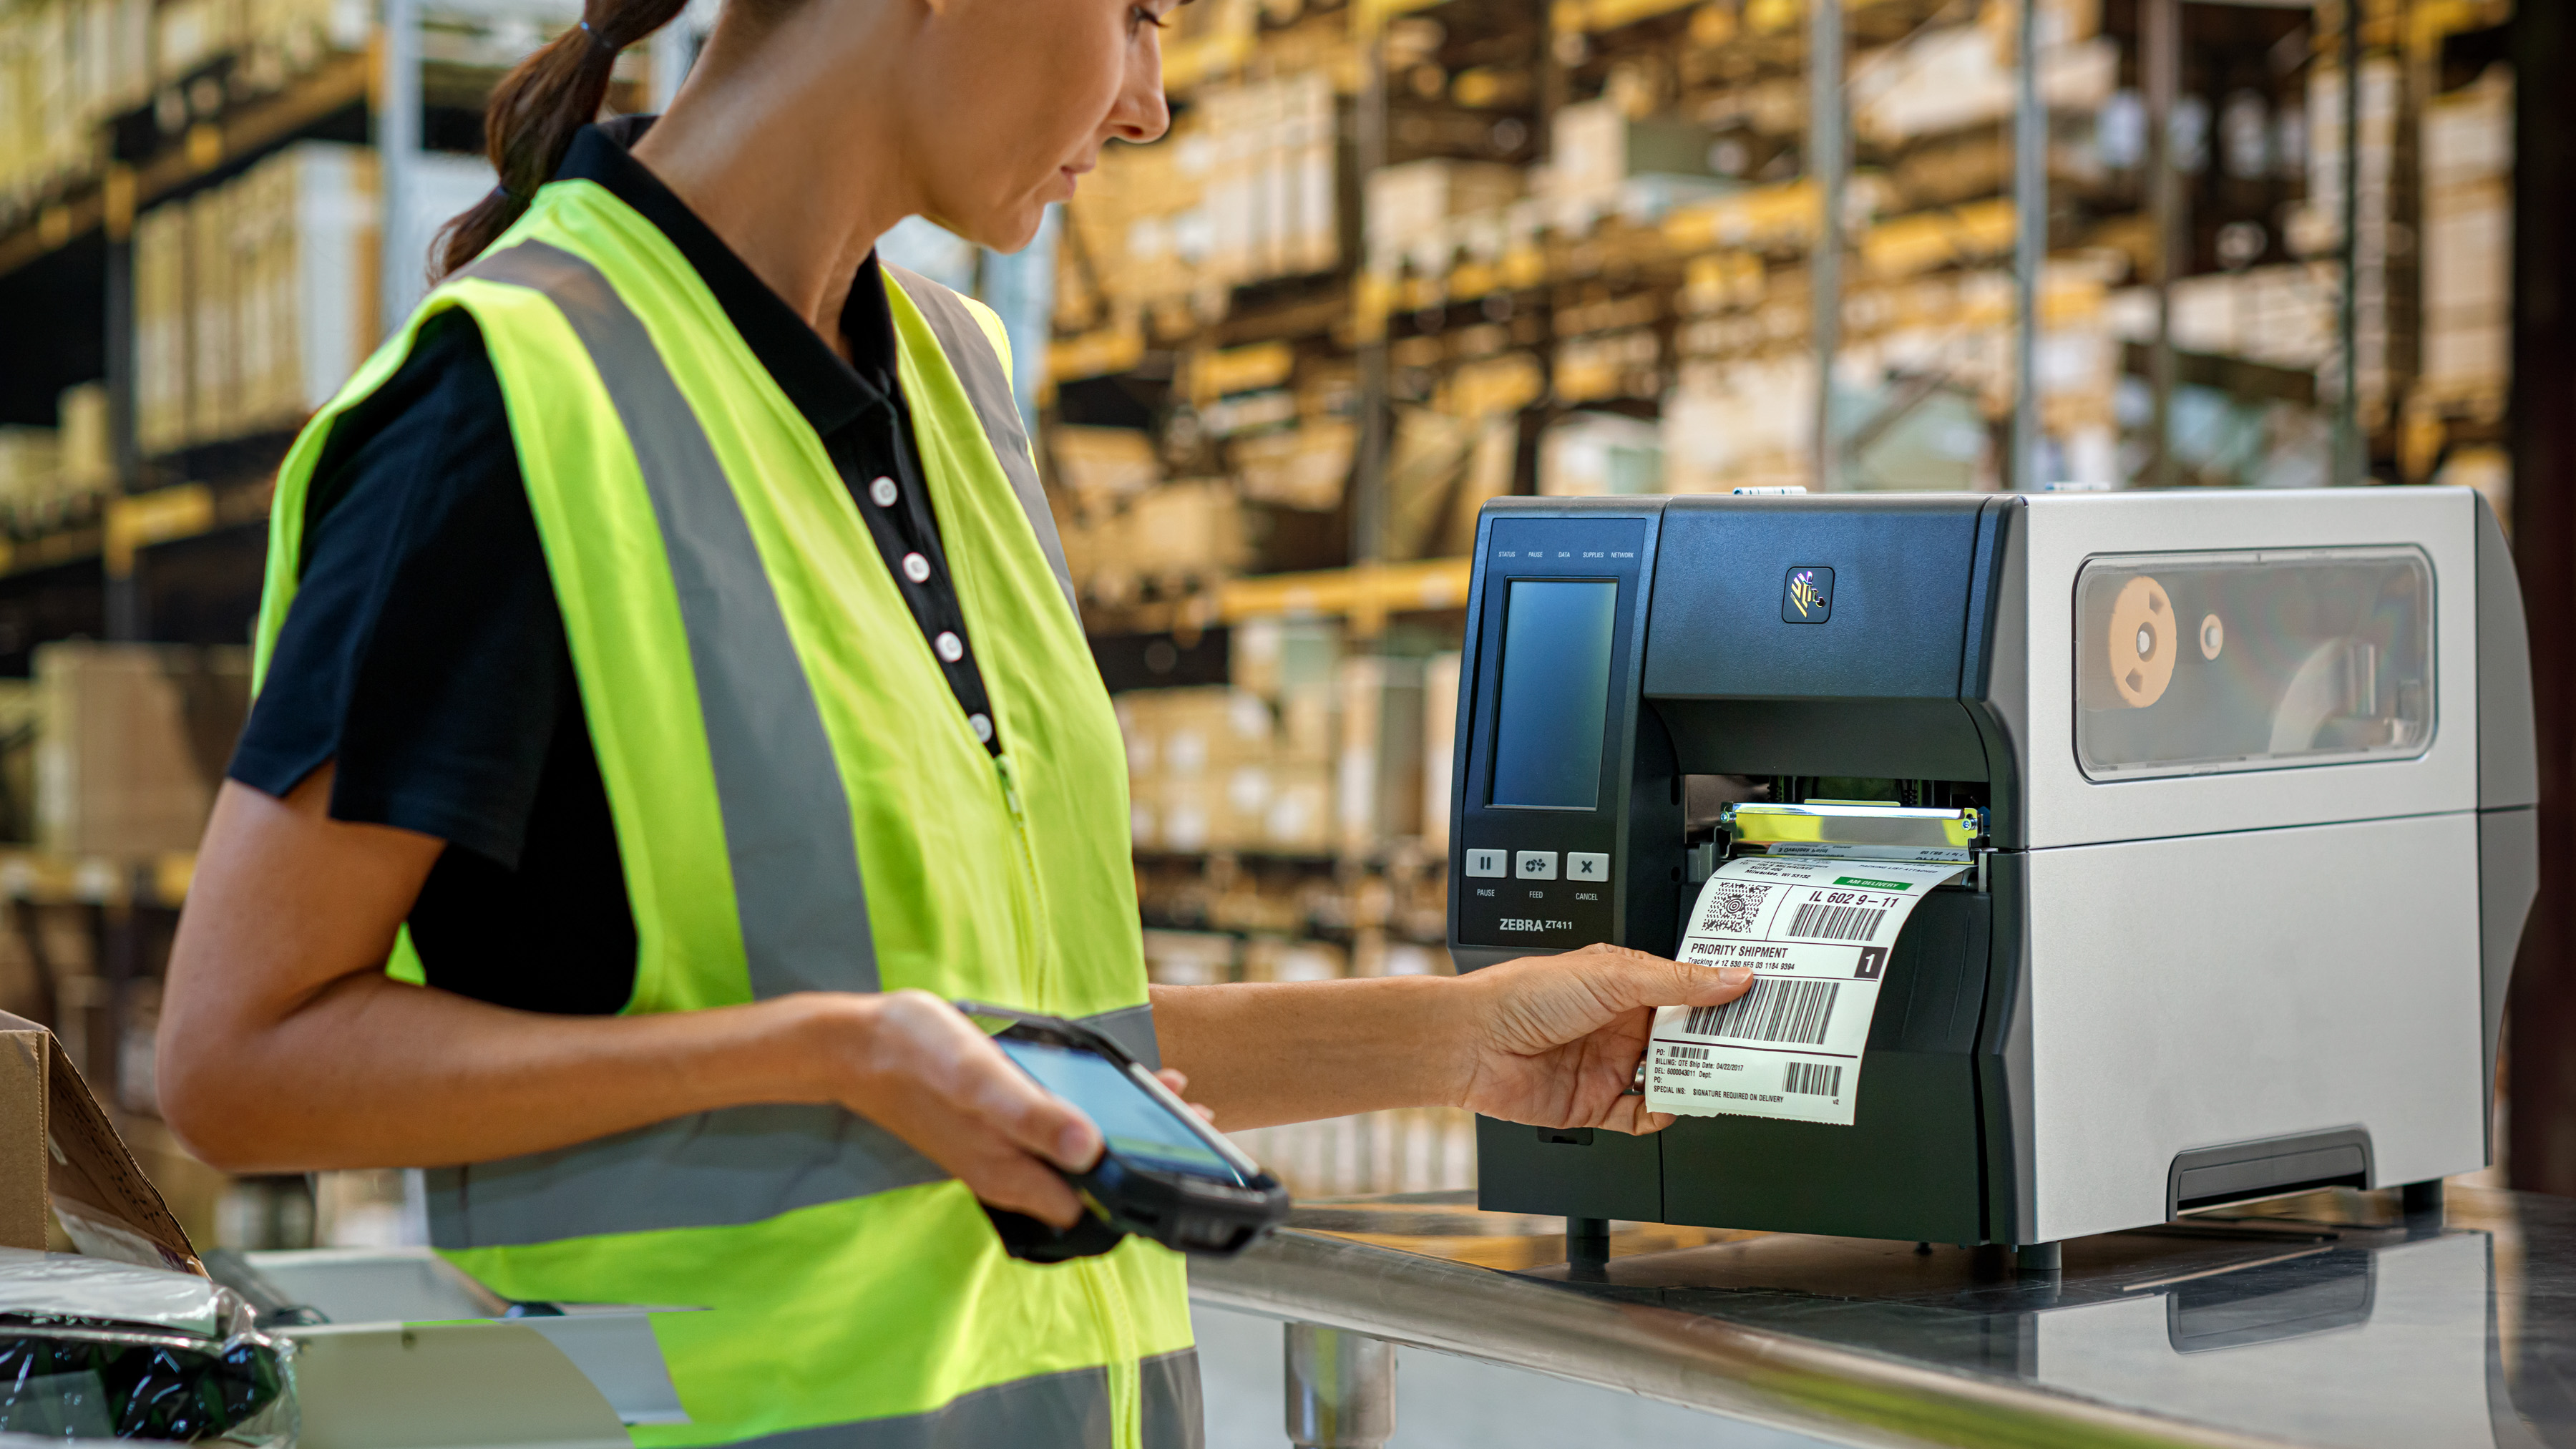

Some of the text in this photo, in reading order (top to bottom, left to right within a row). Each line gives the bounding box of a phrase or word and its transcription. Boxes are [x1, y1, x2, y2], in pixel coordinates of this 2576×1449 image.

[1861, 880, 1900, 889] DELIVERY
[1808, 890, 1823, 902] IL
[1827, 892, 1855, 904] 602
[1499, 918, 1573, 932] ZEBRA ZT411
[1690, 943, 1788, 959] PRIORITY SHIPMENT
[1688, 957, 1714, 967] Tracking
[1865, 953, 1876, 973] 1
[1655, 1058, 1677, 1066] BILLING:
[1716, 1063, 1744, 1071] 04/22/2017
[1667, 1068, 1695, 1077] 6000043011
[1654, 1085, 1674, 1094] SPECIAL
[1693, 1088, 1722, 1098] SIGNATURE
[1722, 1091, 1748, 1101] REQUIRED
[1759, 1094, 1784, 1103] DELIVERY
